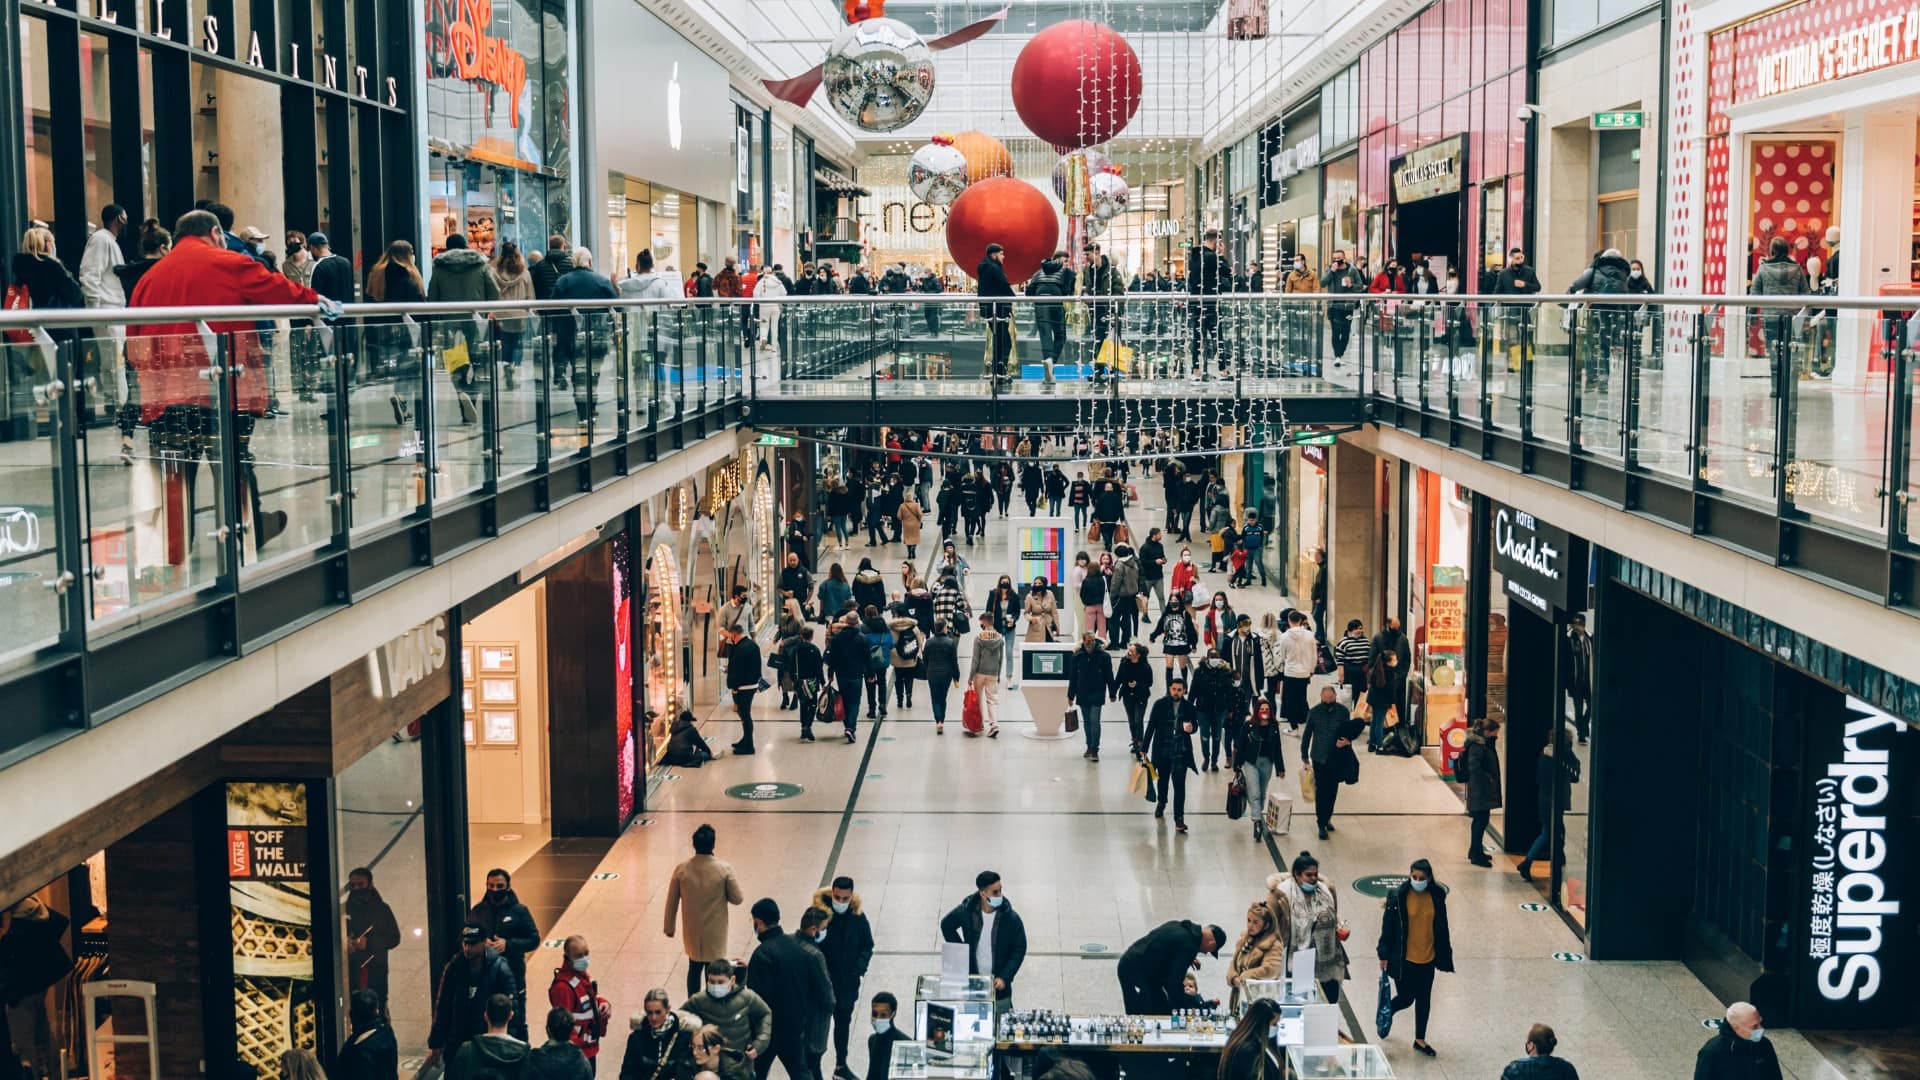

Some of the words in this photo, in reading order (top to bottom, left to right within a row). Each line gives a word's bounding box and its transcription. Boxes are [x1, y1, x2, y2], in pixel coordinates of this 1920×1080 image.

[28, 0, 398, 108] LLSAINTS
[1757, 36, 1838, 98] VICTORIA'S
[1836, 15, 1905, 78] SECRET
[883, 201, 948, 233] ne
[1516, 510, 1536, 532] HOTEL
[1430, 607, 1445, 617] UP
[1447, 607, 1461, 617] TO
[1434, 599, 1458, 608] NOW
[254, 846, 285, 860] THE
[1817, 694, 1908, 1001] Superdry
